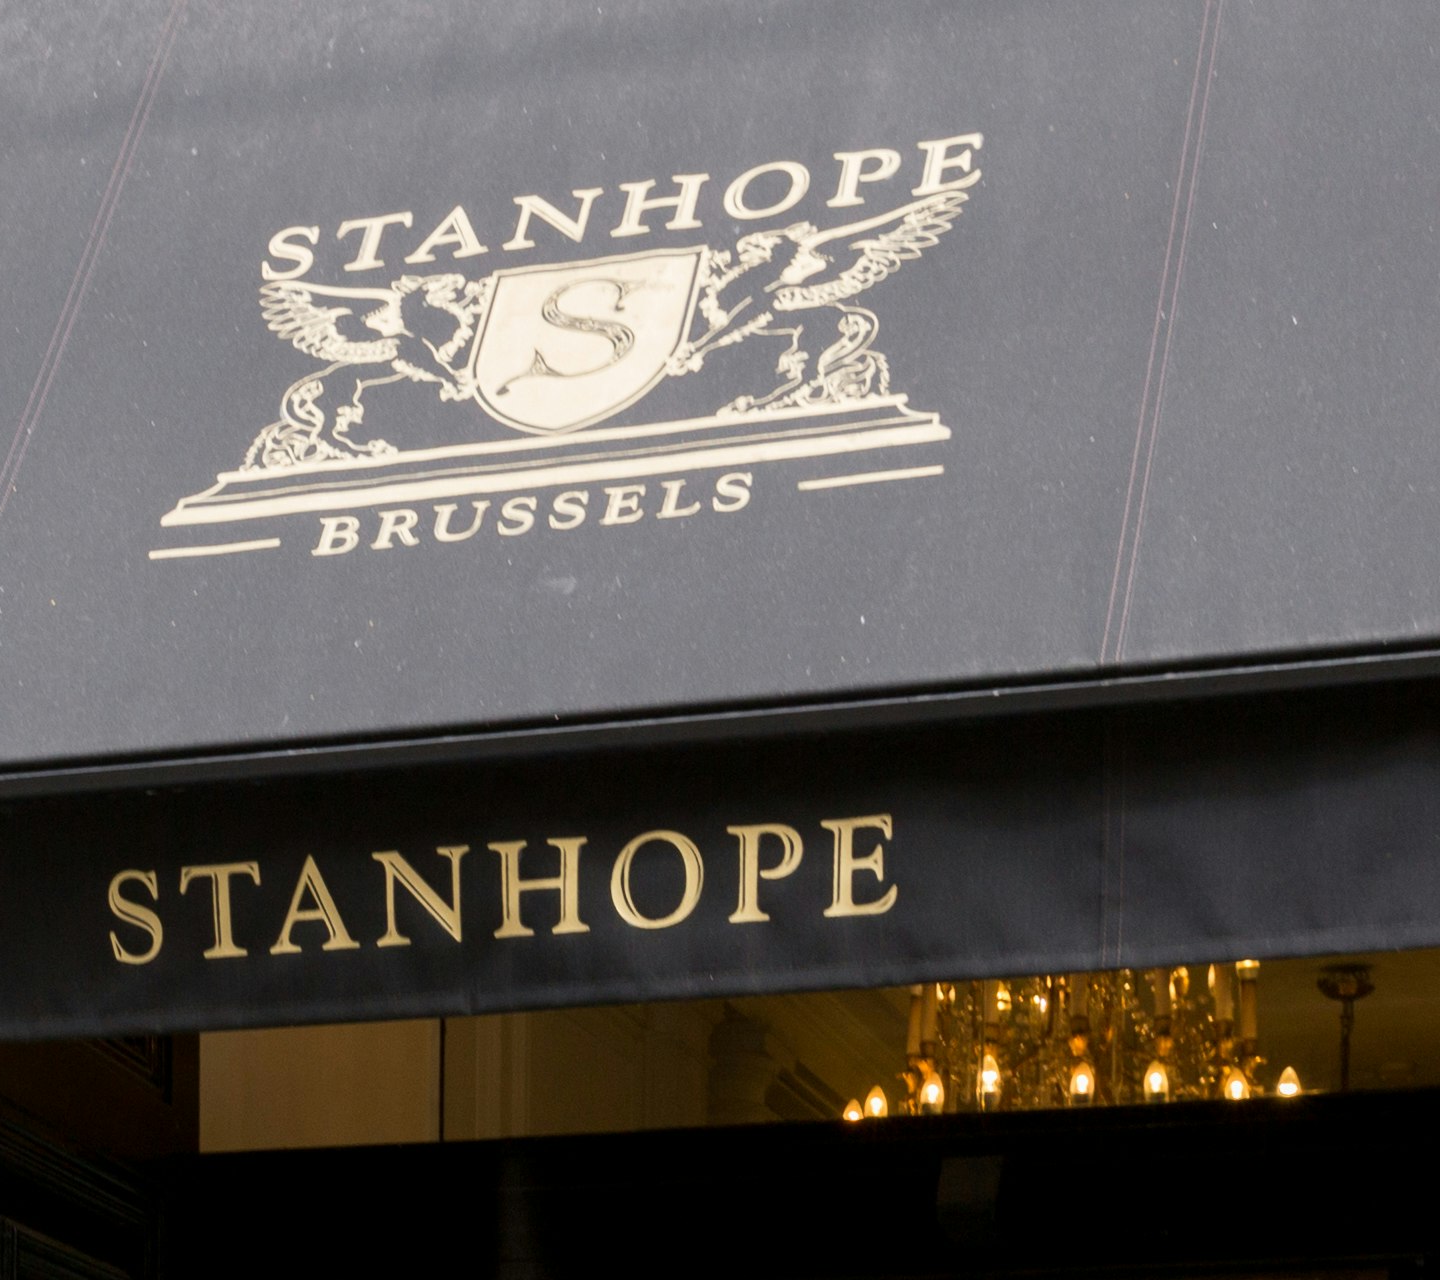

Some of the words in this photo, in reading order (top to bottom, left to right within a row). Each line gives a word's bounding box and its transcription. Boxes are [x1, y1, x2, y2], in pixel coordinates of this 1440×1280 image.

[260, 132, 985, 282] STANHOPE
[496, 277, 633, 396] S
[310, 472, 756, 558] BRUSSELS
[108, 813, 899, 965] STANHOPE
